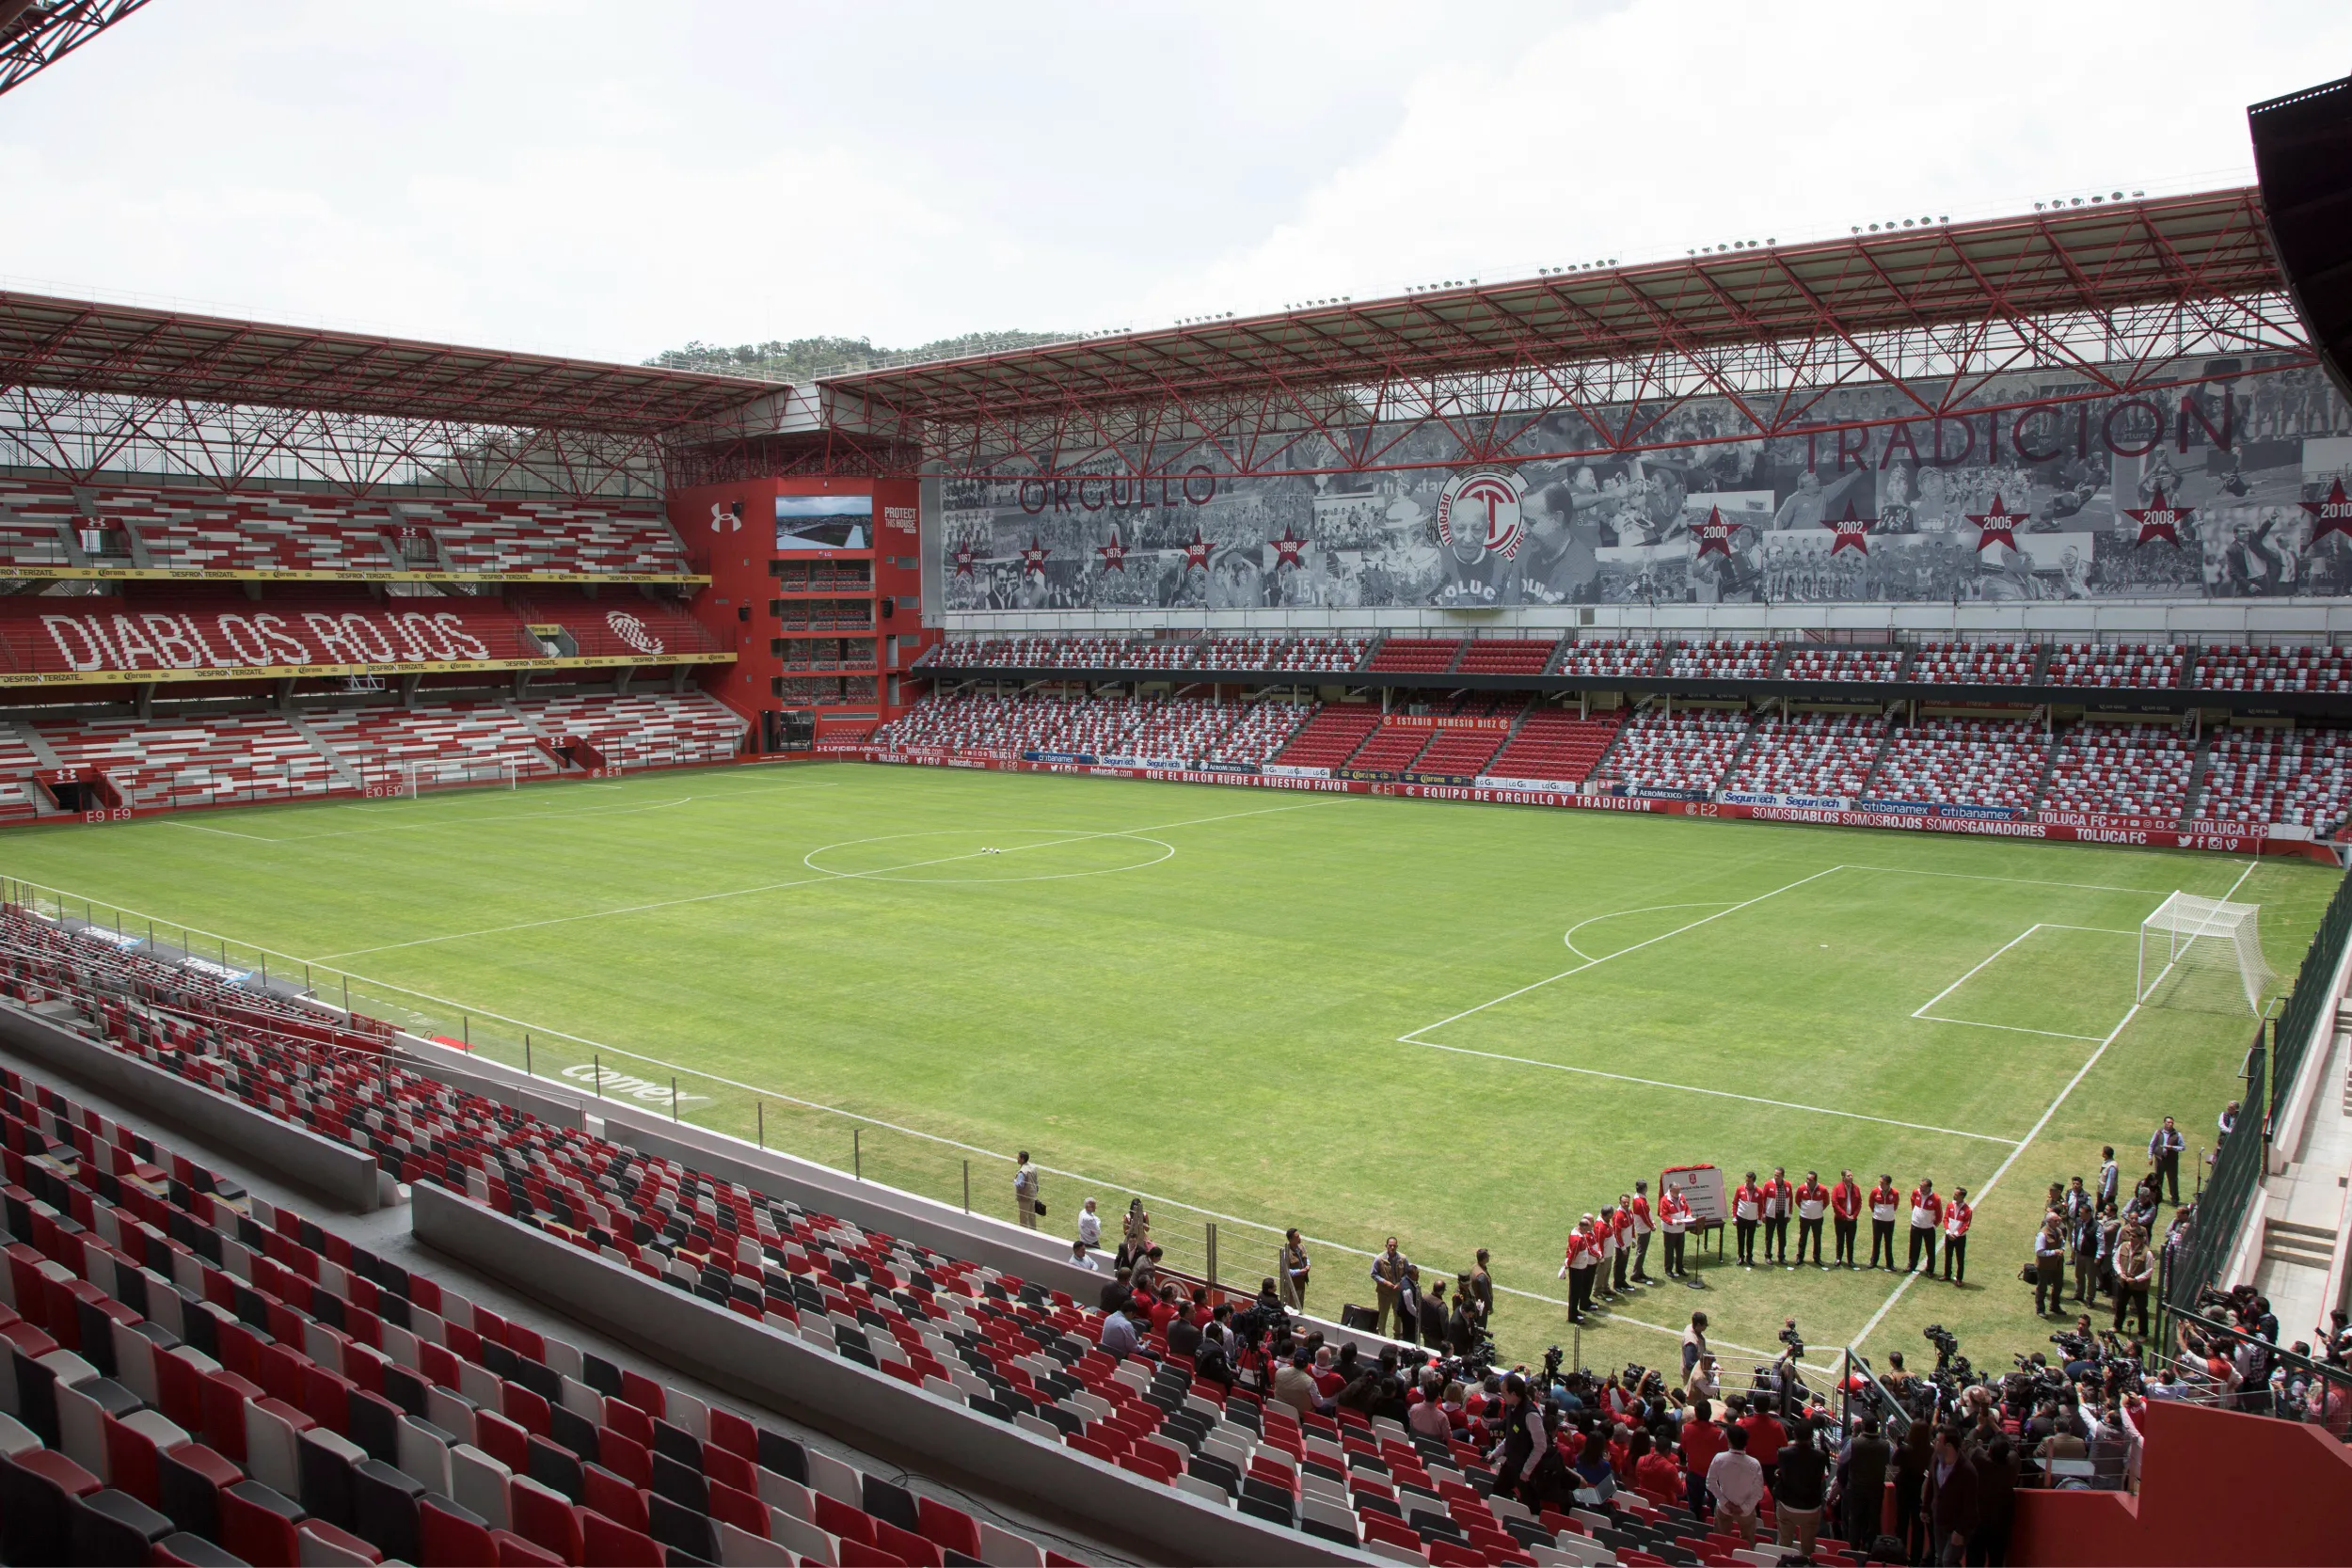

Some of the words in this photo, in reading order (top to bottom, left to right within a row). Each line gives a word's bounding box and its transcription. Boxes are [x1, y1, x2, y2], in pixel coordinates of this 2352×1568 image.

[1019, 465, 1216, 515] ORGULLO
[884, 506, 916, 519] PROTECT
[2320, 503, 2352, 518] 2010
[885, 517, 896, 528] THIS
[896, 518, 916, 529] HOUSE
[1983, 516, 2011, 531] 2005
[2143, 510, 2175, 526] 2008
[1703, 526, 1727, 539] 2000
[1837, 521, 1864, 534] 2002
[1106, 547, 1121, 558] 1975
[1189, 545, 1205, 556] 1998
[1279, 542, 1297, 553] 1999
[958, 554, 971, 563] 1967
[1028, 550, 1041, 561] 1968
[1296, 579, 1311, 598] 15
[40, 613, 311, 672] DIABLOS
[301, 612, 490, 663] ROJOS
[298, 666, 323, 674] Corona
[450, 661, 471, 670] Corona
[124, 671, 151, 680] Corona
[1397, 717, 1432, 726] ESTADIO
[1438, 718, 1473, 728] NEMESIO
[1477, 720, 1496, 729] DIEZ
[906, 745, 944, 756] tolucafc.com
[879, 753, 899, 764] TOLUCA
[900, 754, 909, 764] FC
[947, 758, 986, 768] tolucafc.com
[1090, 766, 1133, 778] tolucafc.com
[1146, 769, 1164, 780] QUE
[1168, 771, 1178, 782] EL
[1216, 773, 1248, 785] RUEDE
[1253, 775, 1260, 786] A
[1263, 777, 1310, 790] NUESTRO
[1314, 780, 1348, 792] FAVOR
[1420, 774, 1445, 784] Corona
[366, 787, 383, 799] E10
[387, 784, 403, 797] E10
[1423, 786, 1469, 800] EQUIPO
[1475, 789, 1489, 801] DE
[1496, 791, 1554, 805] ORGULLO
[1561, 795, 1568, 806] Y
[1724, 791, 1777, 805] SeguriTech
[1785, 796, 1839, 809] SeguriTech
[1700, 803, 1718, 817] E2
[1862, 800, 1928, 816] citibanamex
[1941, 807, 2010, 820] citibanamex
[87, 810, 105, 823] E9
[113, 809, 132, 821] E9
[2037, 811, 2087, 826] TOLUCA
[2090, 815, 2106, 828] FC
[2191, 820, 2247, 836] TOLUCA
[2250, 824, 2268, 837] FC
[2075, 827, 2129, 844] TOLUCA
[2130, 831, 2147, 845] FC
